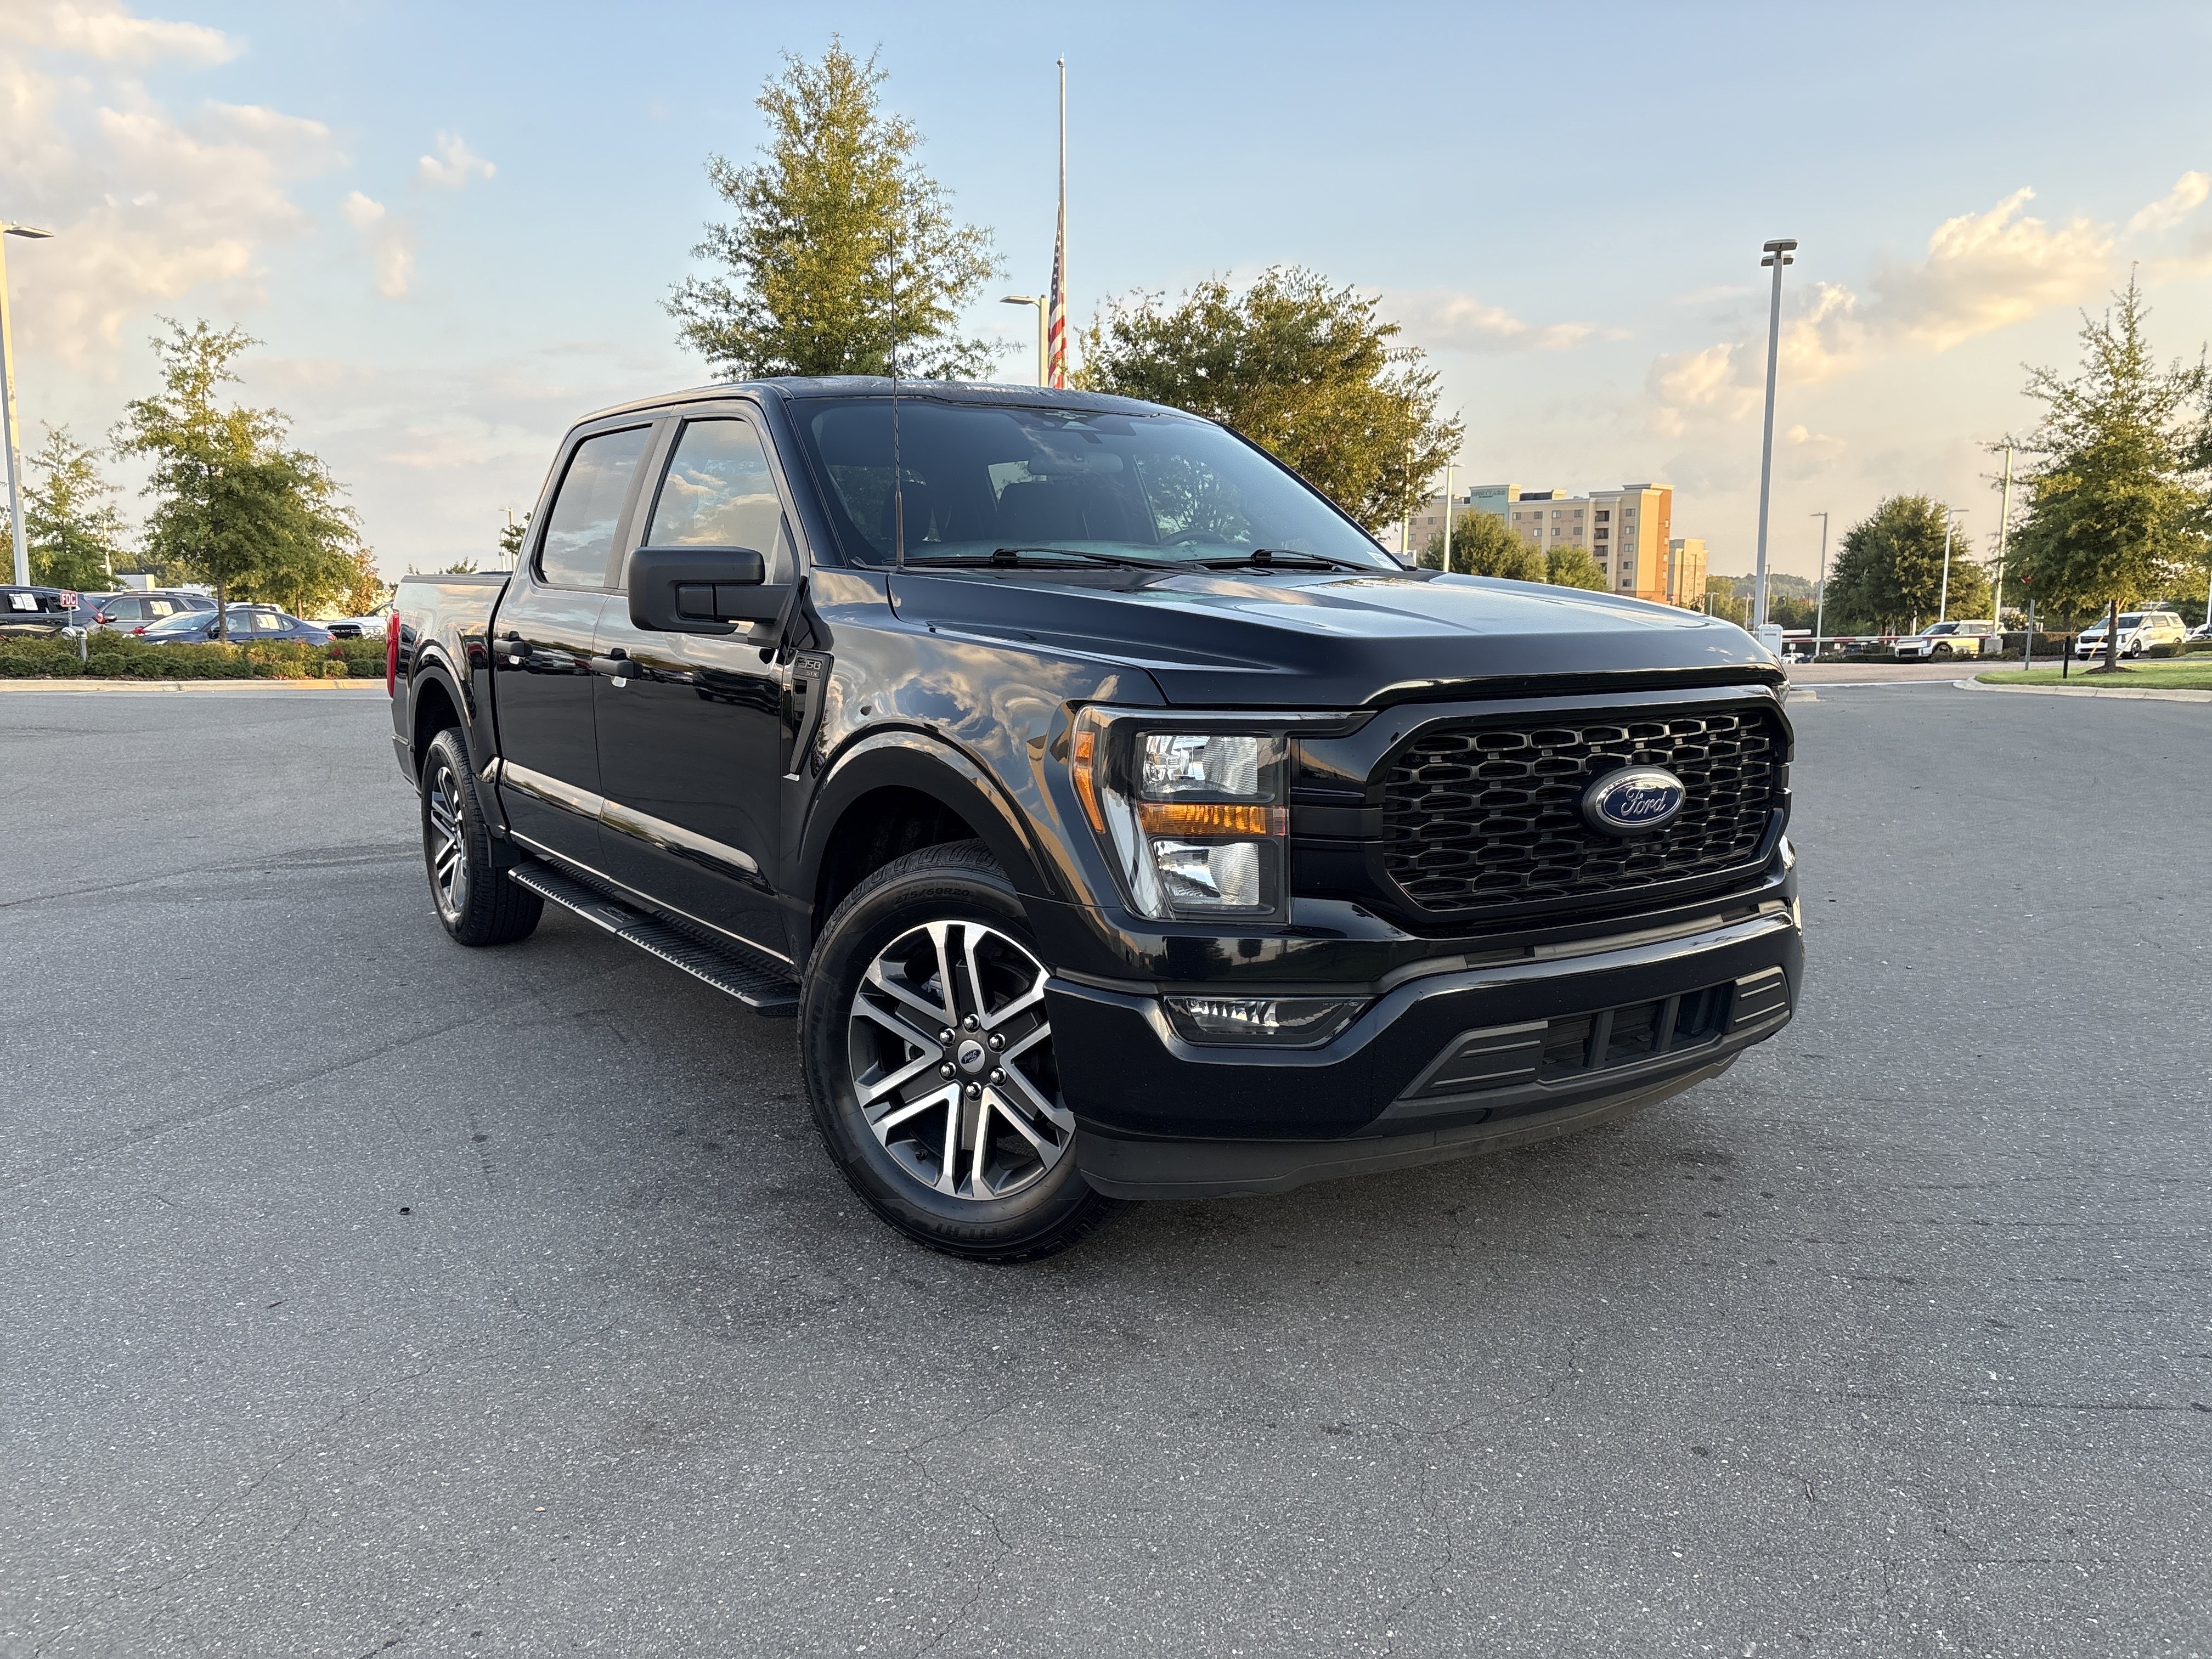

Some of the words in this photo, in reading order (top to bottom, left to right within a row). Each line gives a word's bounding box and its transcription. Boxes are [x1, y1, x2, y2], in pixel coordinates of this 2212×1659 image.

[61, 593, 76, 605] FDC
[1621, 786, 1667, 816] Ford
[895, 888, 970, 905] 275/60R20
[963, 1051, 977, 1063] Ford
